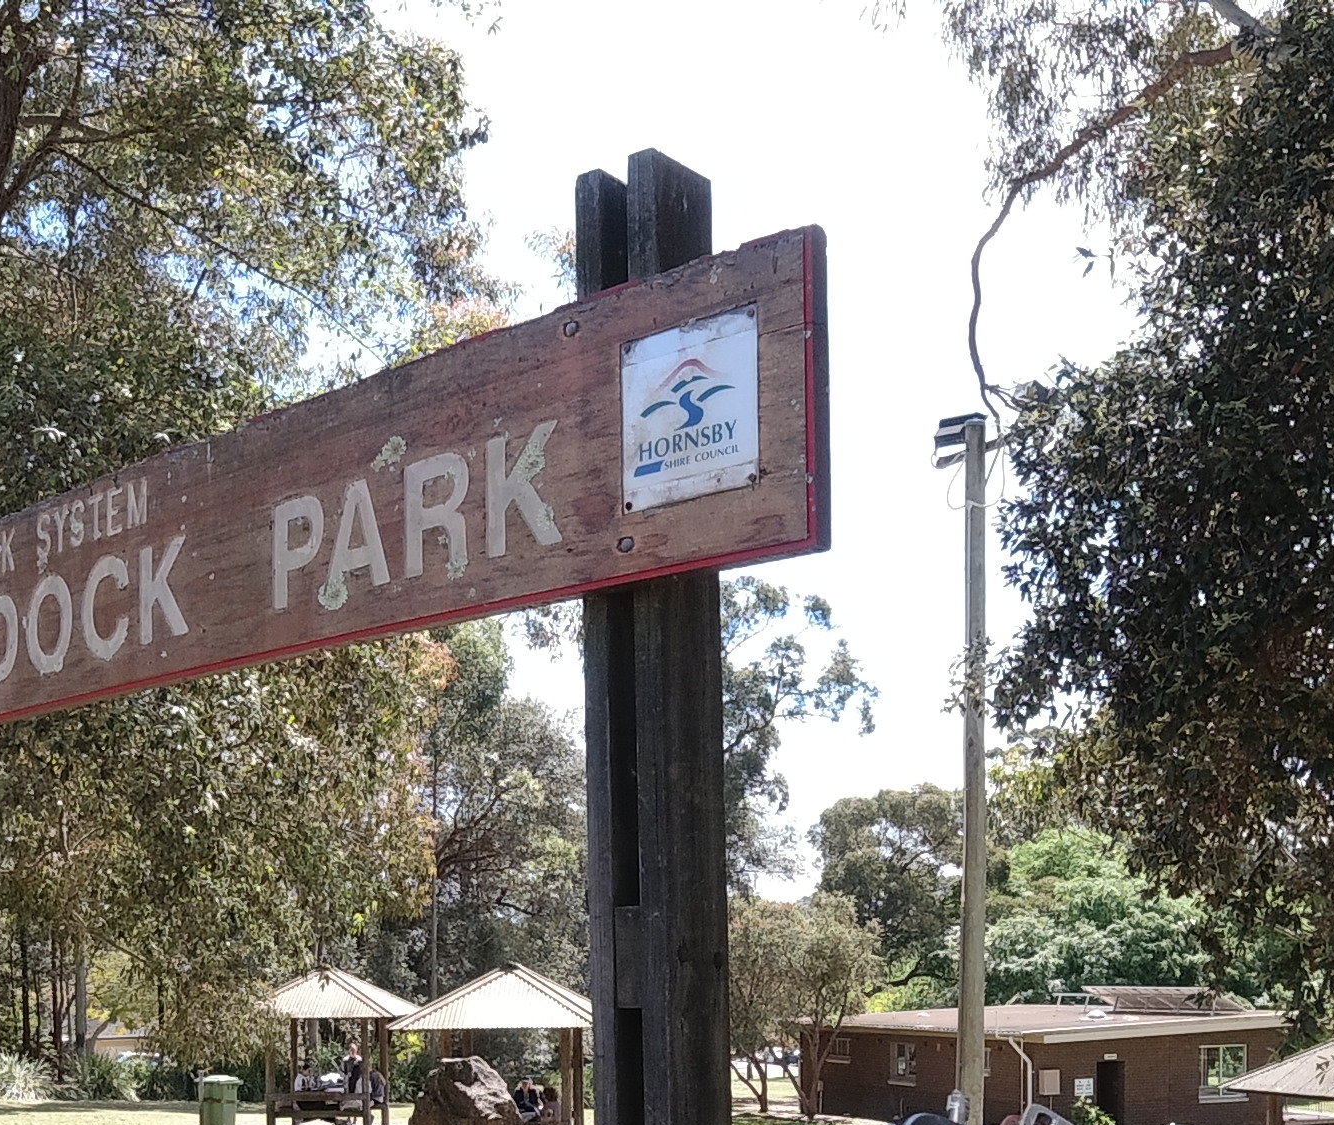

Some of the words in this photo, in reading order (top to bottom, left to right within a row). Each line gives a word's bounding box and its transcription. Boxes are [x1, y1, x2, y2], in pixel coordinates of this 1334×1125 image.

[639, 419, 737, 462] HORNSBY
[663, 456, 691, 471] SHIRE
[694, 444, 740, 462] COUNCIL
[35, 478, 149, 557] SYSTEM
[271, 420, 563, 611] PARK
